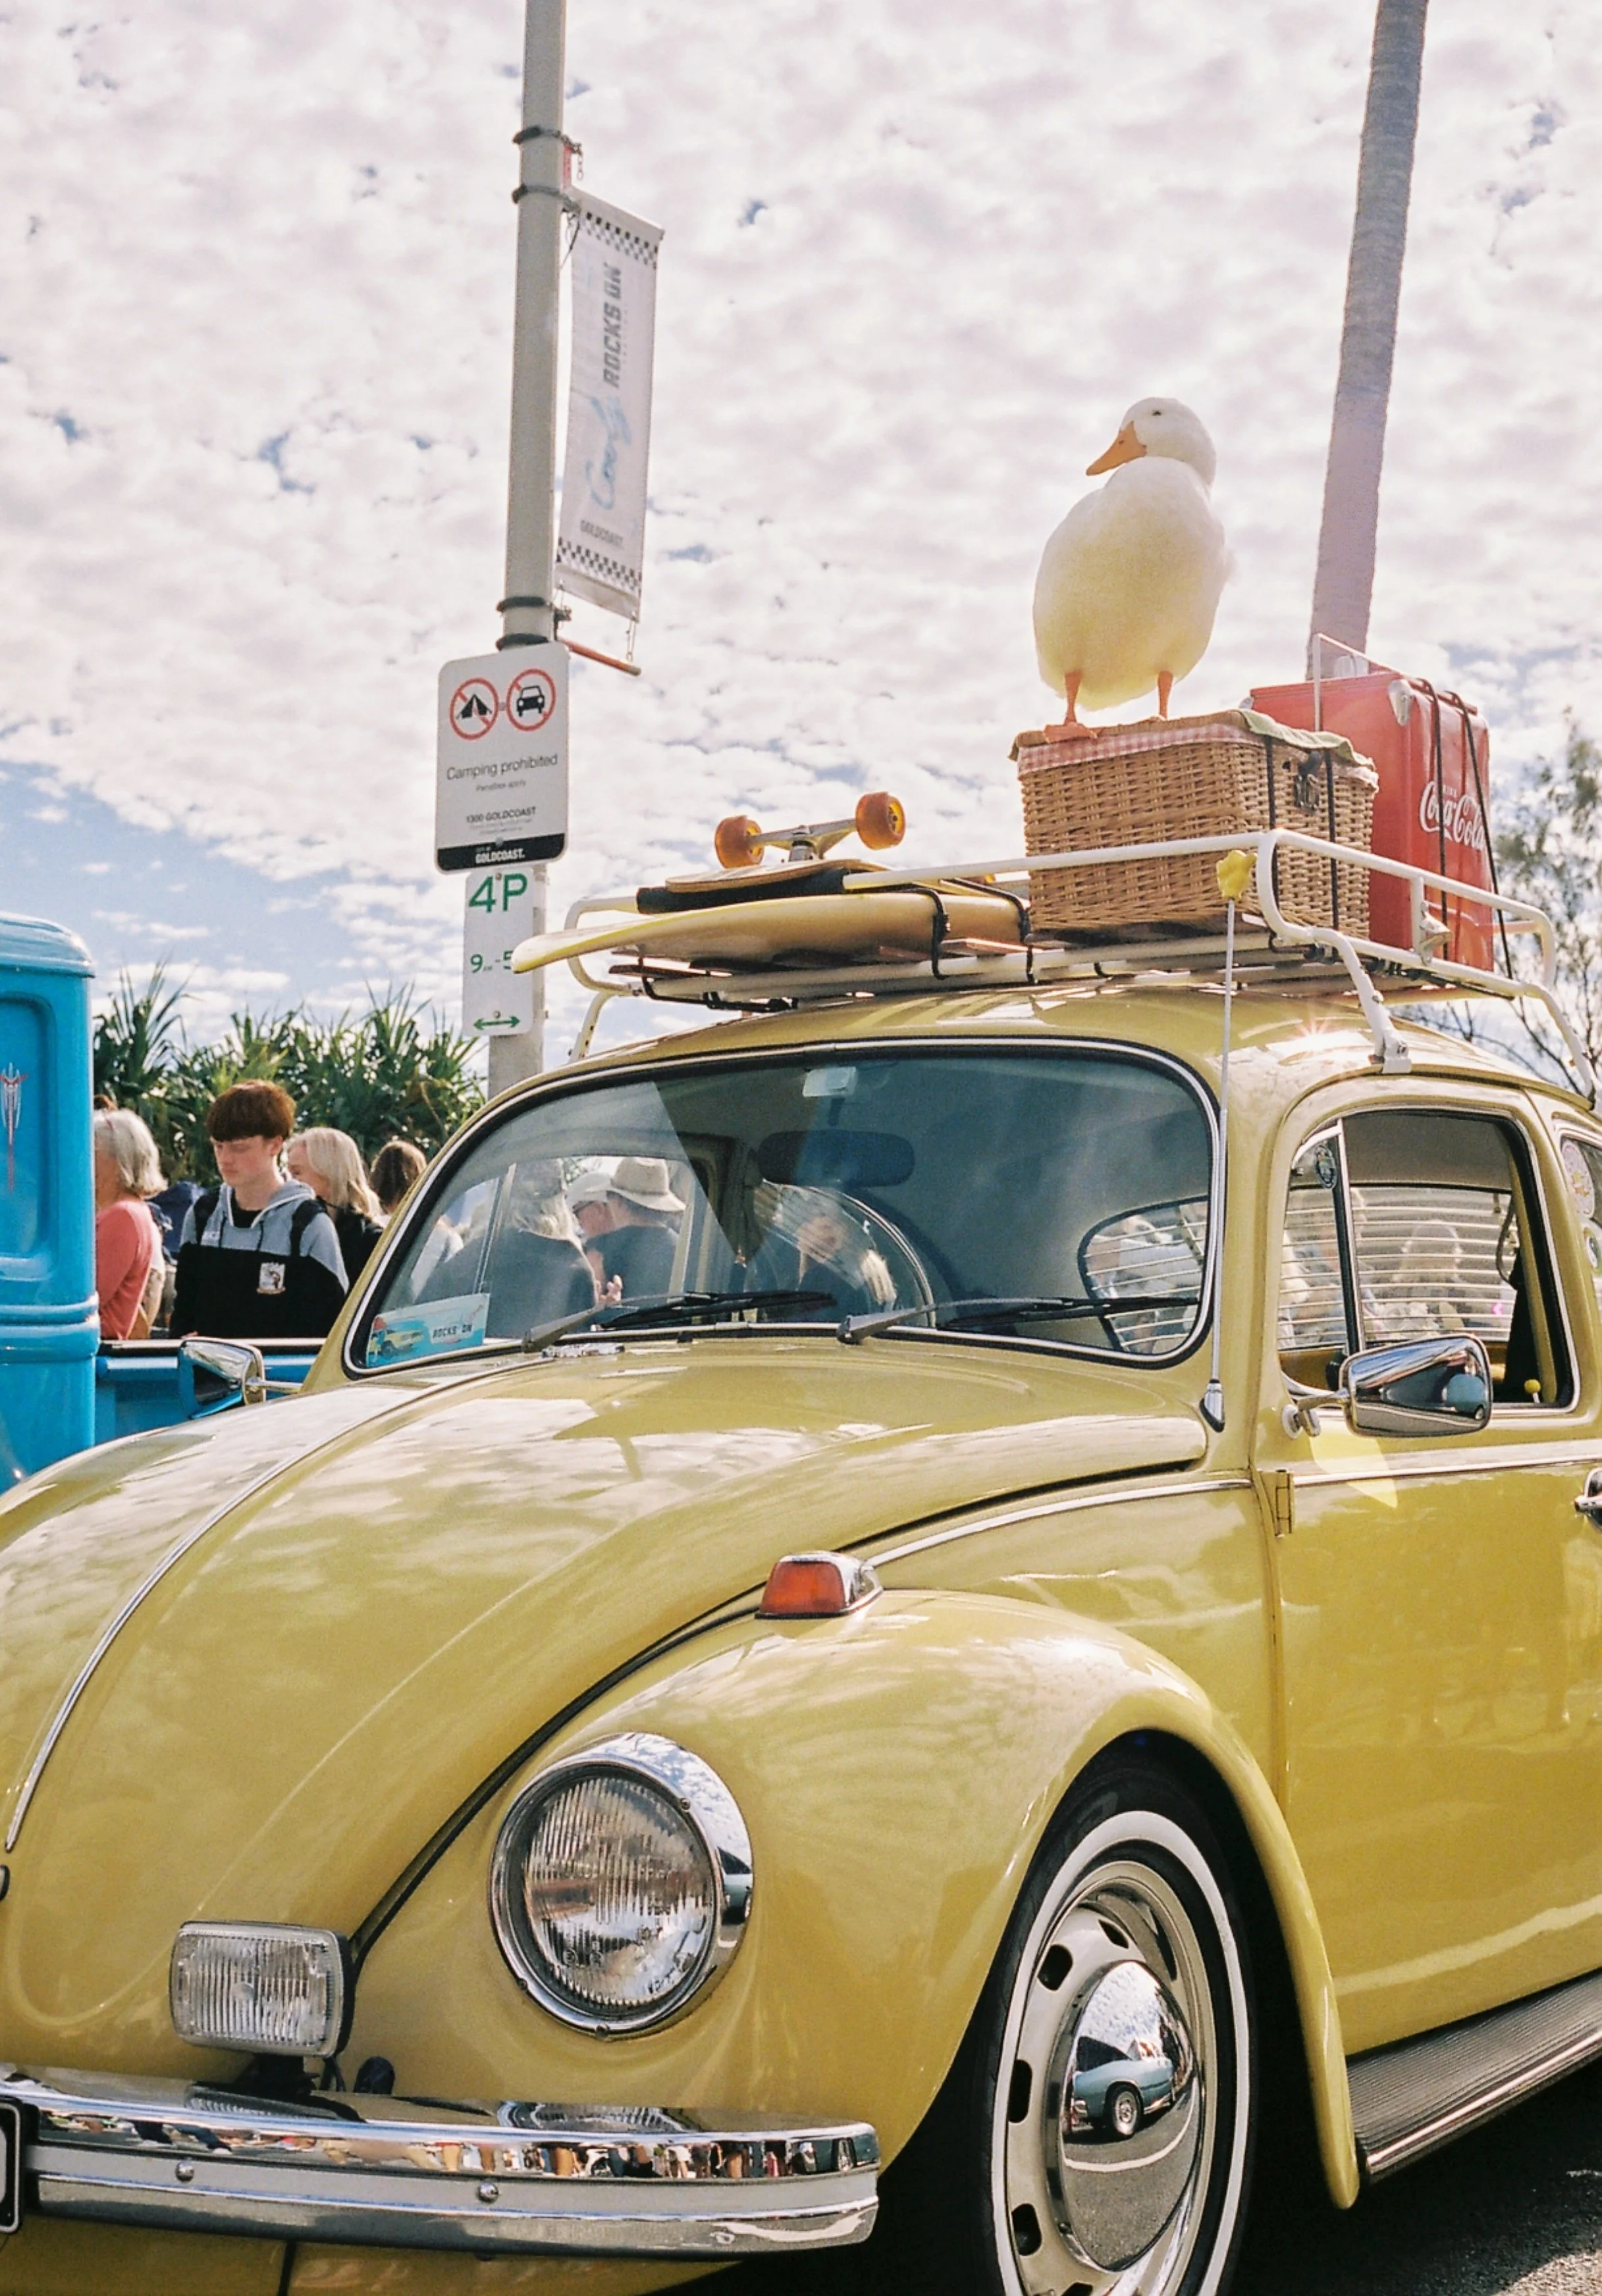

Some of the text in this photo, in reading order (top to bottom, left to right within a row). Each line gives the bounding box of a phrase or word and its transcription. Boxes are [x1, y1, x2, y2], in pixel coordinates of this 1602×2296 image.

[602, 262, 622, 300] ON
[602, 301, 621, 389] ROCKS
[446, 754, 558, 780] Camping prohibited
[485, 806, 537, 822] GOLDCOAST
[468, 873, 527, 913] 4P
[433, 1326, 458, 1338] ROCKS
